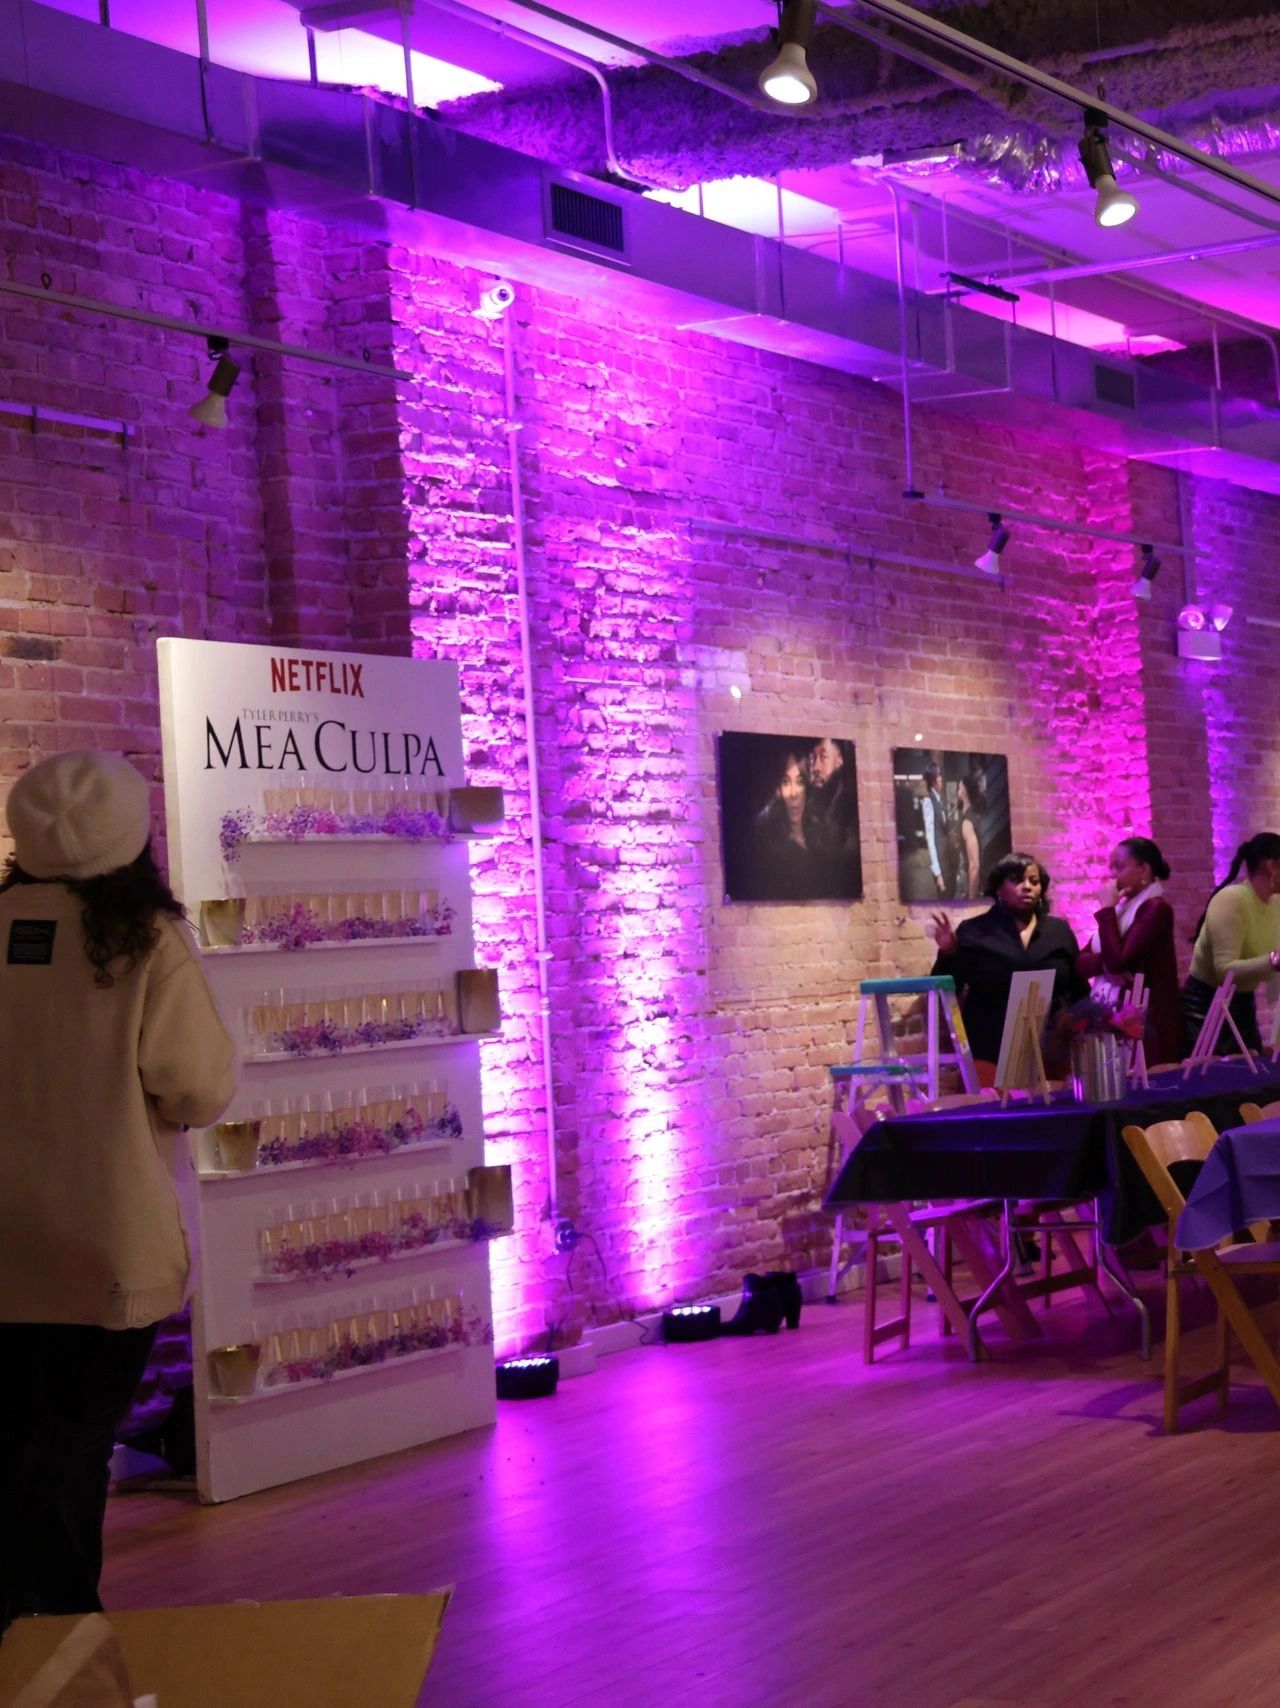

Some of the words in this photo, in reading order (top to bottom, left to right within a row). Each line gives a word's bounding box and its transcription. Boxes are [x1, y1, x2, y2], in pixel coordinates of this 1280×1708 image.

[271, 657, 366, 698] NETFLIX
[242, 708, 275, 721] TYLER
[204, 715, 308, 771] MEA
[314, 720, 446, 776] CULPA
